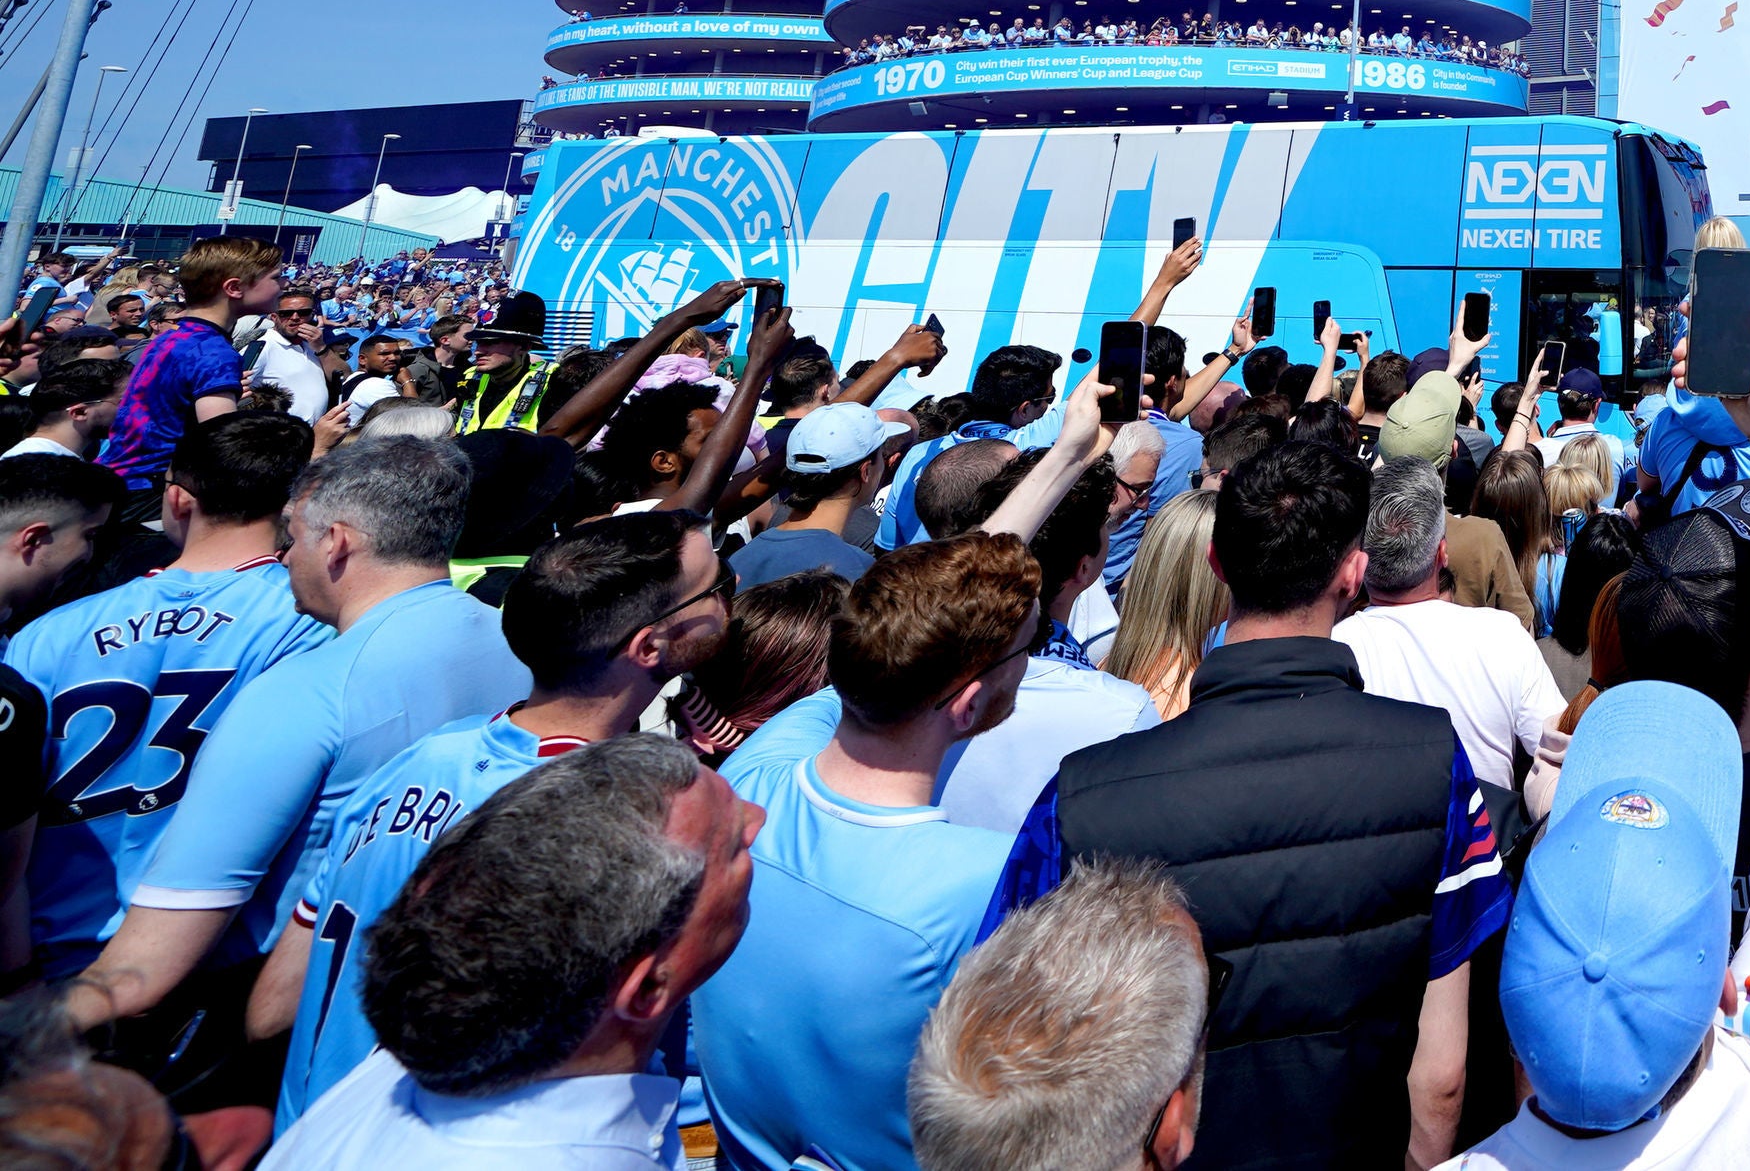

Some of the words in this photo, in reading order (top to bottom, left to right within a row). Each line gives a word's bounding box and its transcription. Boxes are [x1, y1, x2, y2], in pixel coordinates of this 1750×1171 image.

[623, 22, 678, 33] without
[695, 21, 729, 32] love
[732, 21, 750, 32] of
[753, 23, 779, 36] my
[783, 24, 819, 35] own
[873, 60, 946, 96] 1970
[955, 60, 977, 72] City
[999, 58, 1024, 69] their
[1026, 57, 1050, 67] first
[1080, 55, 1137, 67] European
[1138, 56, 1181, 67] trophy,
[955, 70, 1004, 84] European
[1006, 70, 1028, 82] Cup
[1085, 68, 1106, 80] Cup
[1108, 68, 1130, 78] and
[1133, 68, 1177, 80] League
[1180, 69, 1203, 80] Cup
[1347, 59, 1425, 90] 1986
[601, 84, 615, 98] THE
[617, 82, 668, 98] INVISIBLE
[671, 82, 701, 99] MAN,
[703, 82, 742, 96] WE'RE
[745, 82, 769, 96] NOT
[771, 82, 813, 97] REALLY
[1466, 160, 1607, 203] NEXEN
[601, 144, 780, 267] MANCHEST
[555, 224, 577, 252] 18
[1462, 229, 1540, 248] NEXEN
[1546, 229, 1602, 248] TIRE
[797, 121, 1327, 394] CITY
[93, 605, 236, 658] RYBOT
[36, 669, 238, 828] 23
[342, 796, 392, 867] DE
